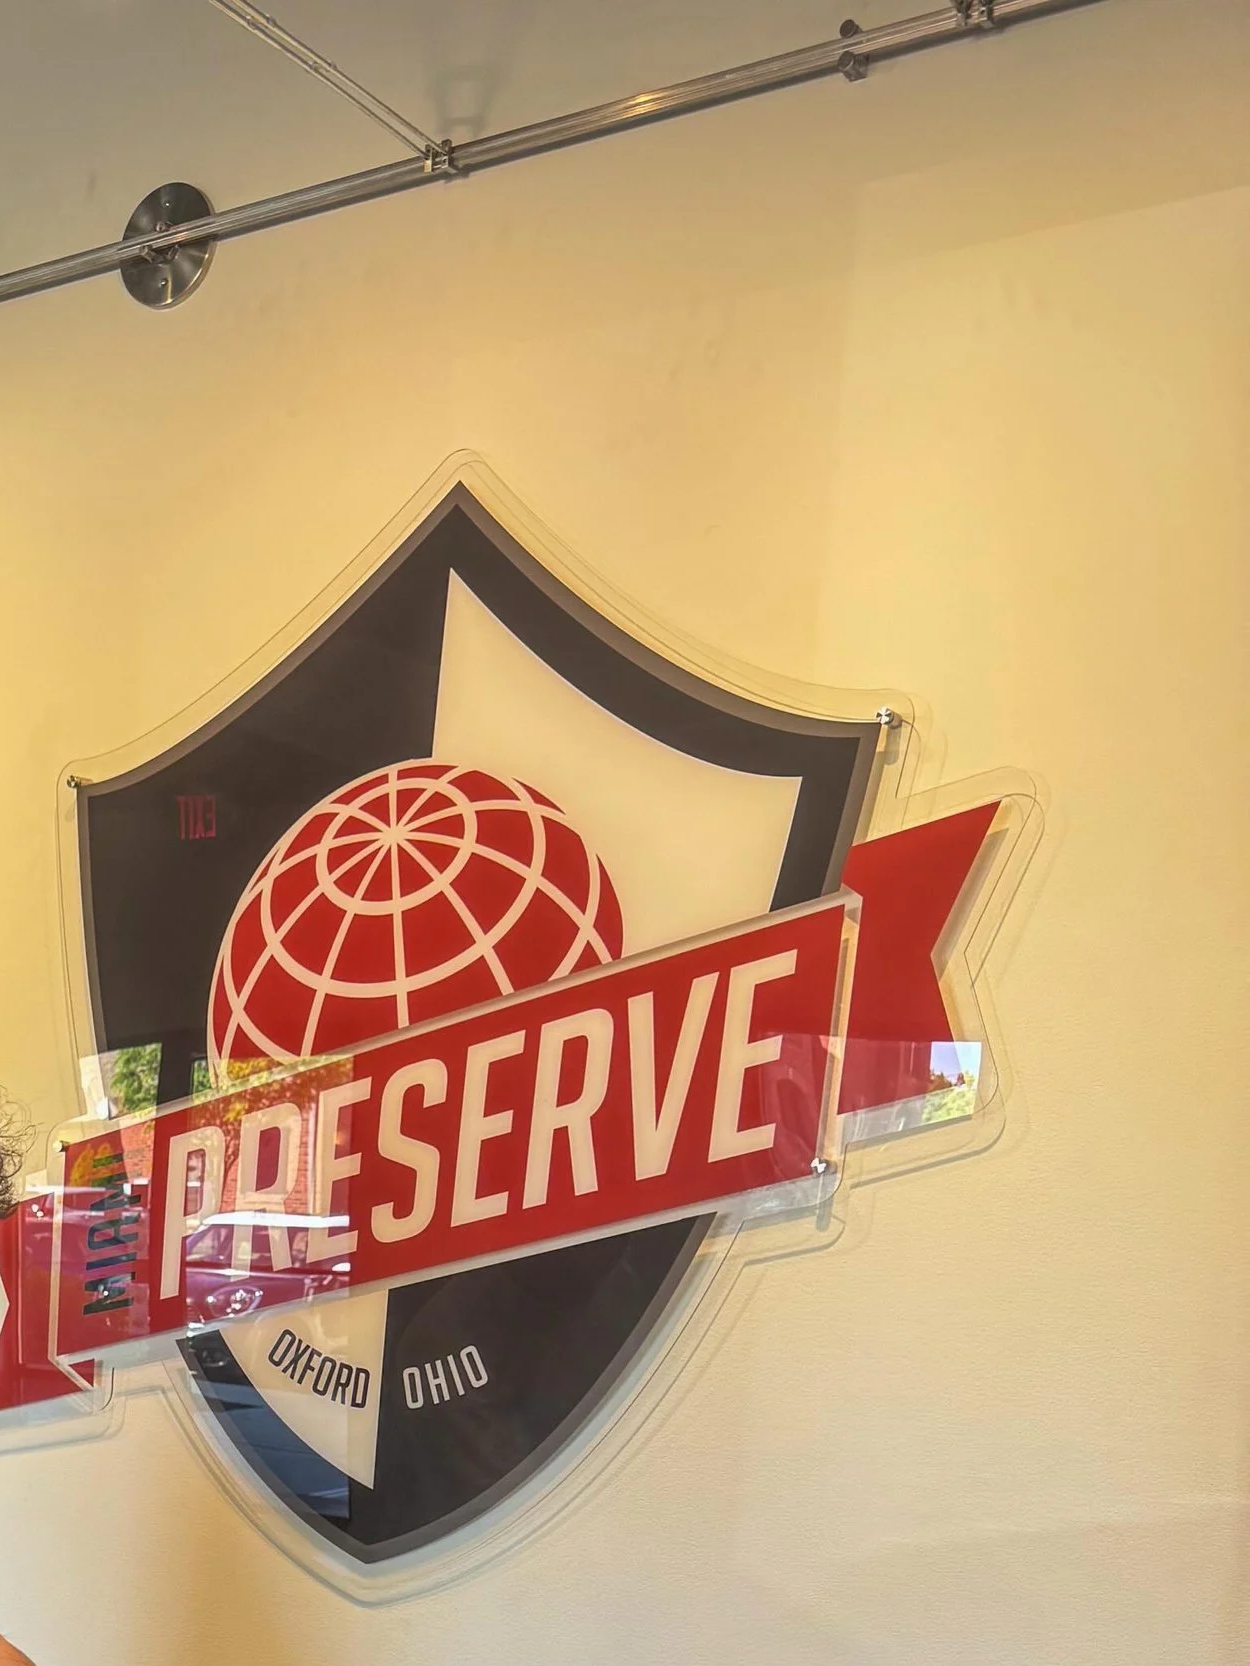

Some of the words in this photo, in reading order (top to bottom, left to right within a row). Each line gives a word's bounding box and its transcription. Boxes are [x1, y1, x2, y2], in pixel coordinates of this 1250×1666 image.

[158, 949, 798, 1300] PRESERVE
[83, 1153, 143, 1317] MIAMI
[268, 1328, 372, 1410] OXFORD
[401, 1345, 489, 1410] OHIO
